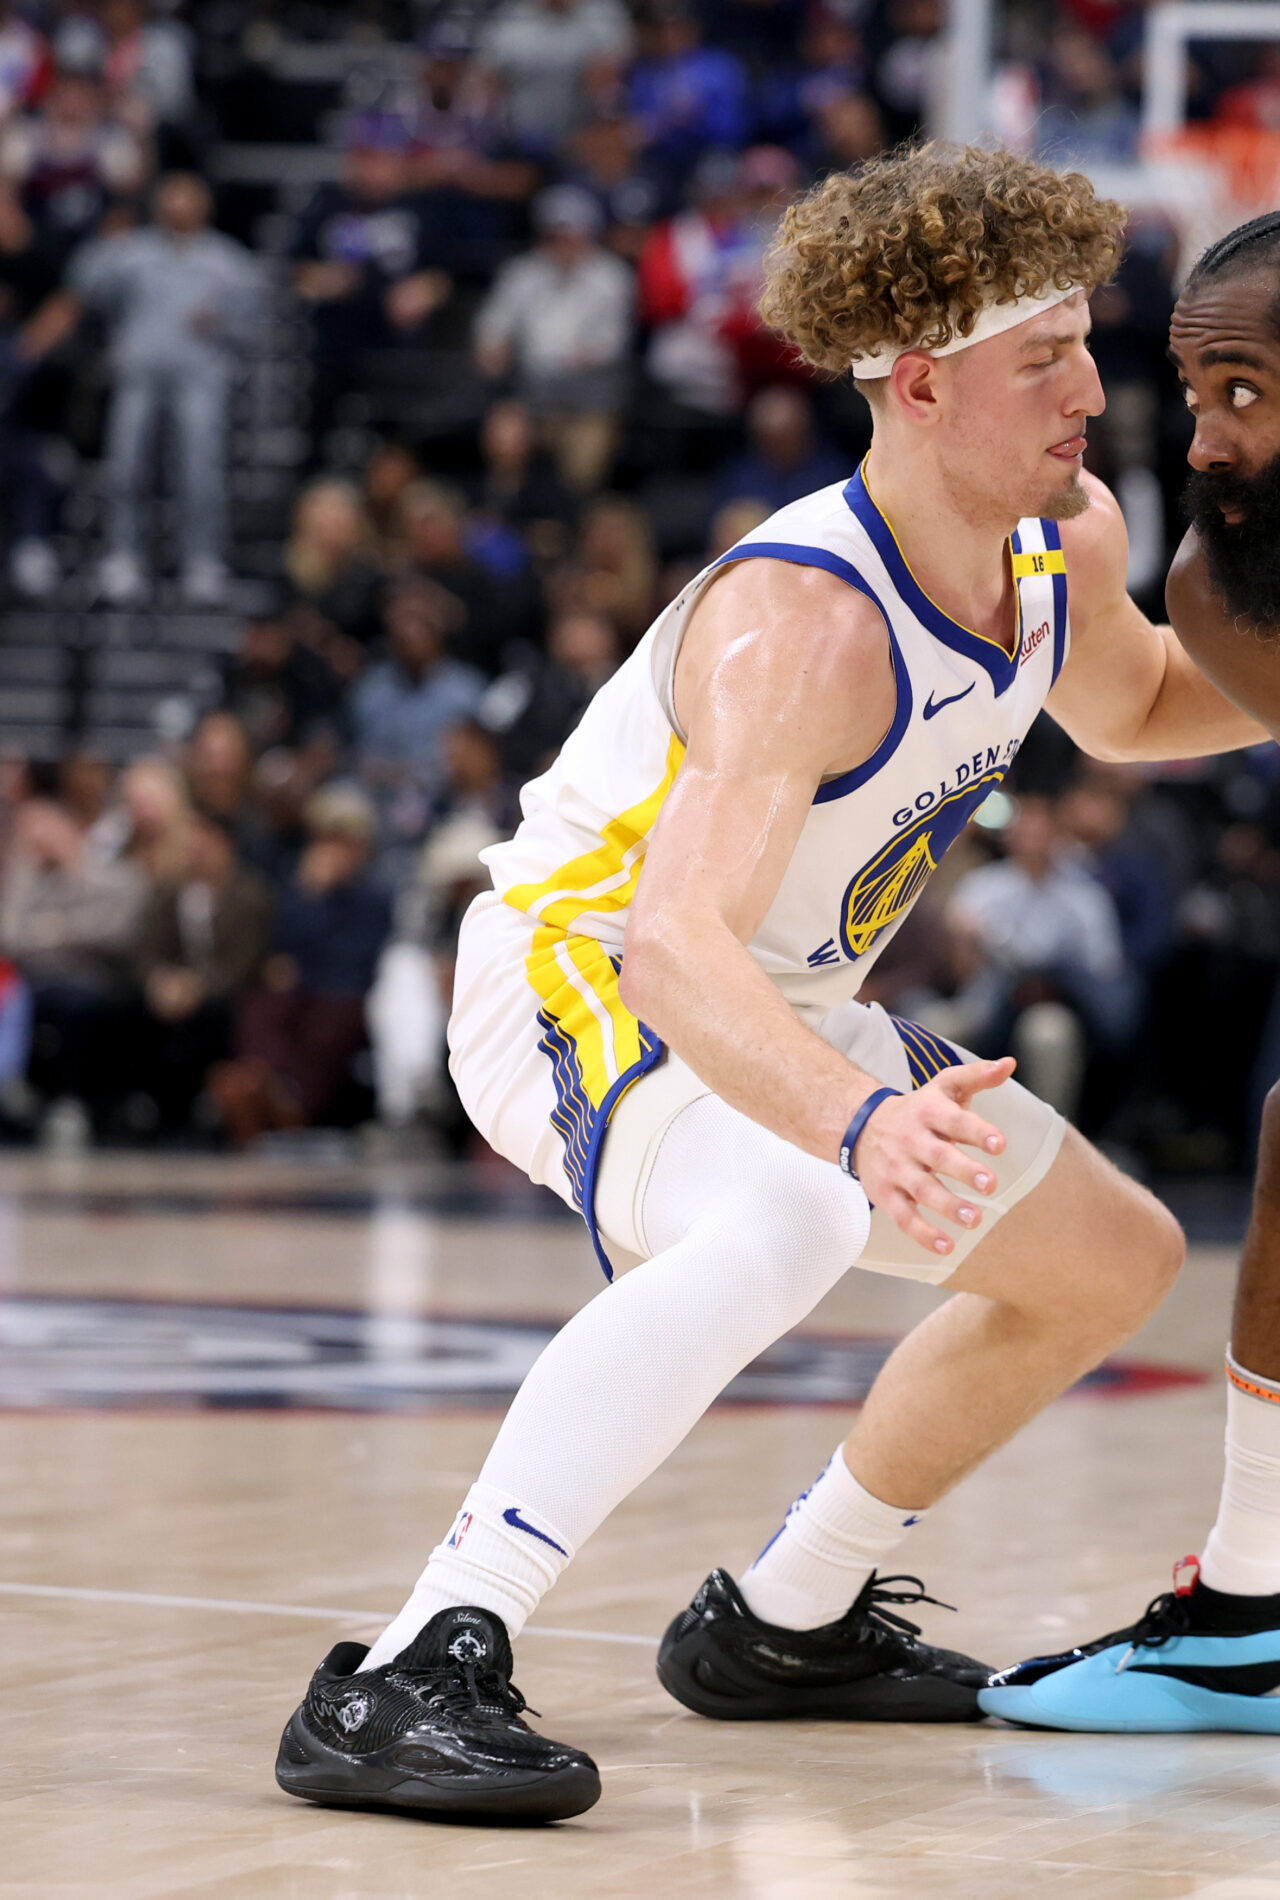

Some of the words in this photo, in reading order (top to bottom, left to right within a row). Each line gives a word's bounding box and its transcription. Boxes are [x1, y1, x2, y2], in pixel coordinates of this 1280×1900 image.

[1032, 555, 1045, 573] 16
[892, 744, 1000, 827] GOLDEN
[452, 1611, 483, 1625] Silent
